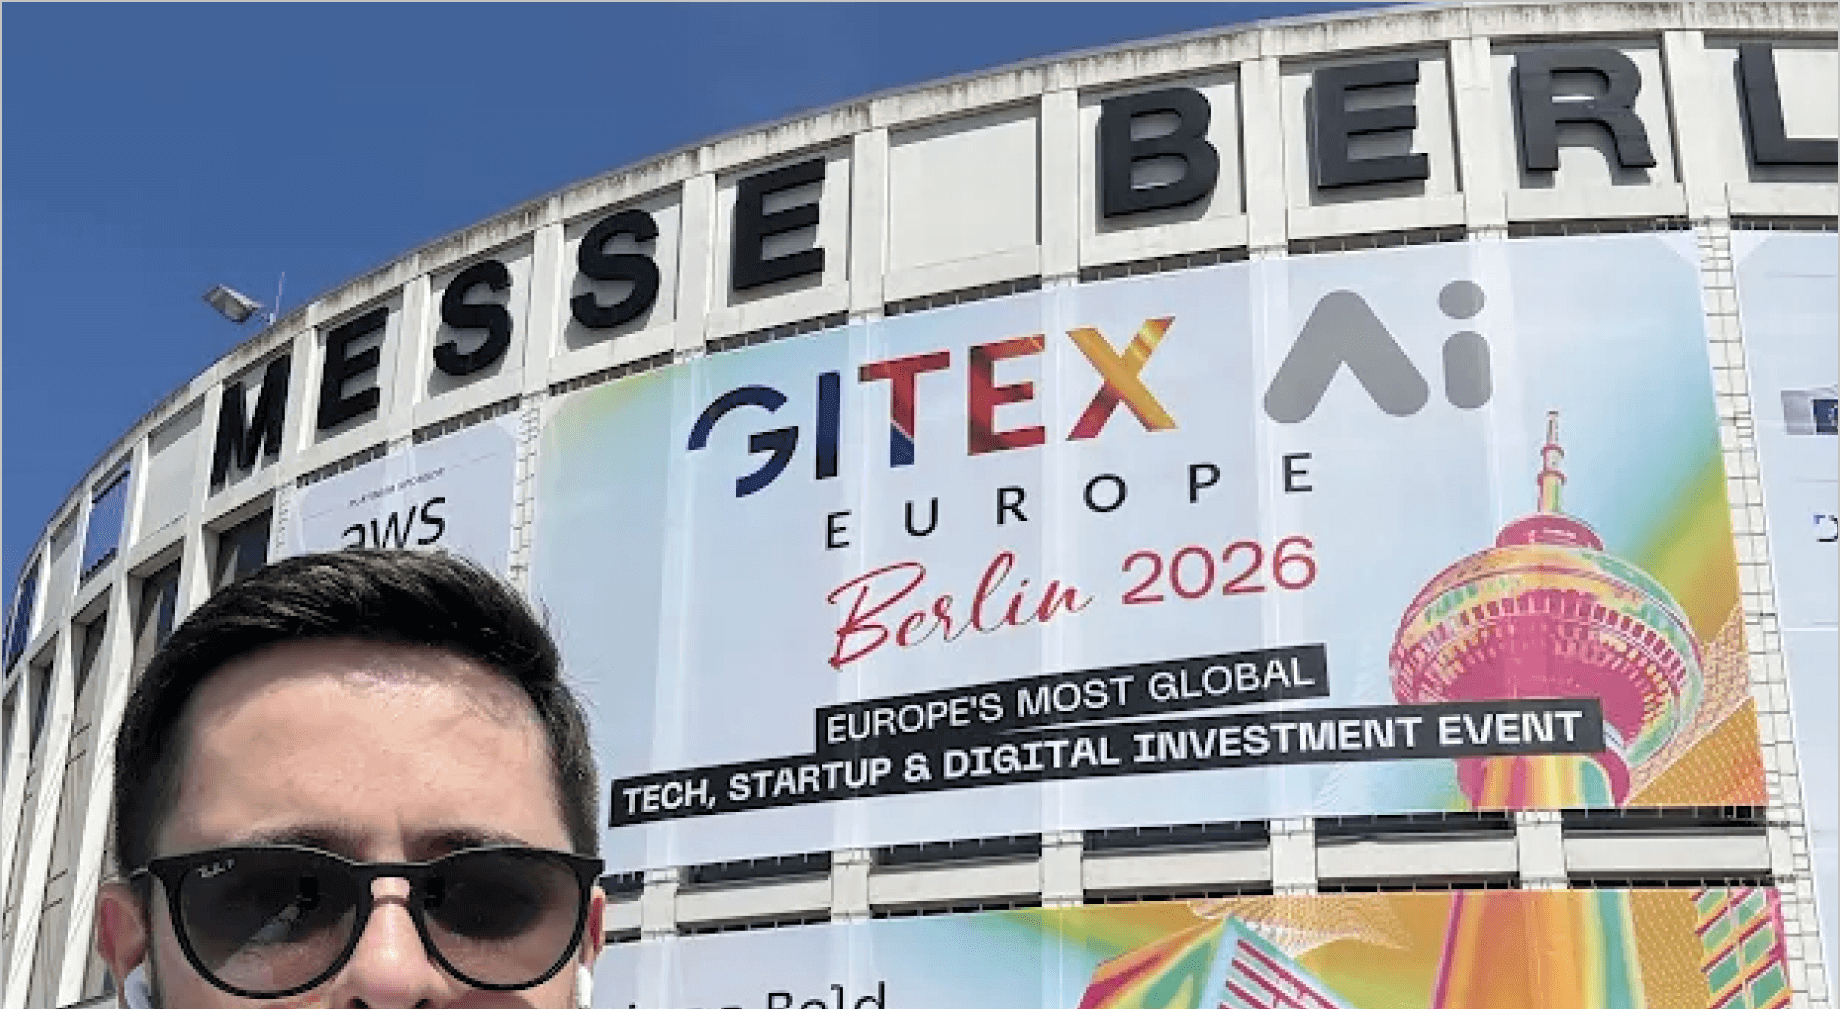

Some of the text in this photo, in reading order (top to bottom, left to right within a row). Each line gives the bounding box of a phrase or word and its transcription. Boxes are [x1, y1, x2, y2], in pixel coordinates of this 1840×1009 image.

[210, 42, 1838, 488] MESSE BERL
[687, 280, 1493, 498] GITEX Ai
[826, 453, 1313, 550] EUROPE
[827, 536, 1317, 669] Berlin 2026
[827, 657, 1315, 743] EUROPE'S MOST GLOBAL
[623, 710, 1582, 817] TECH, STARTUP & DIGITAL INVESTMENT EVENT
